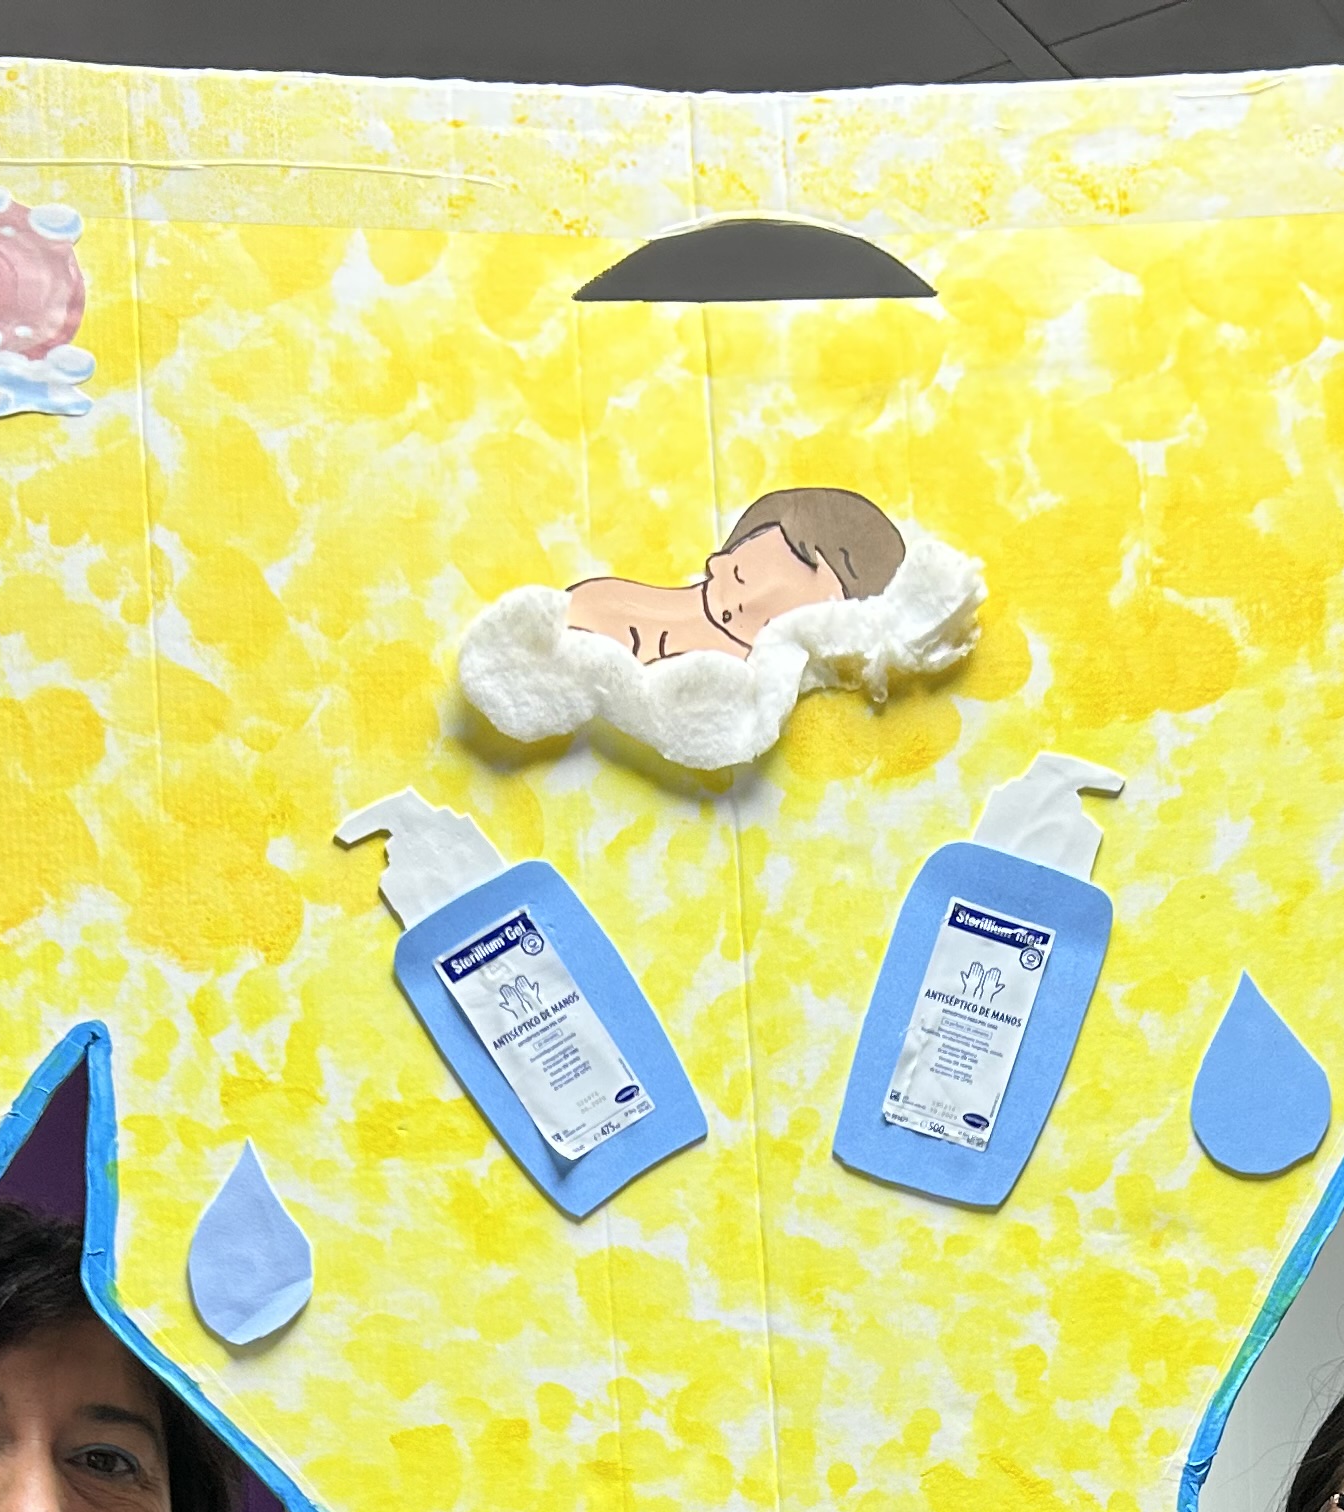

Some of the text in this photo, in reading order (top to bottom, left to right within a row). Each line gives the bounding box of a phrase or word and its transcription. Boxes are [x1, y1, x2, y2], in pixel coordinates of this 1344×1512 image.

[506, 920, 527, 942] Gel
[539, 1008, 553, 1021] DE
[551, 992, 580, 1015] MANOS
[924, 988, 978, 1013] ANTISÉPTICO
[979, 1005, 991, 1017] DE
[991, 1010, 1023, 1027] MANOS
